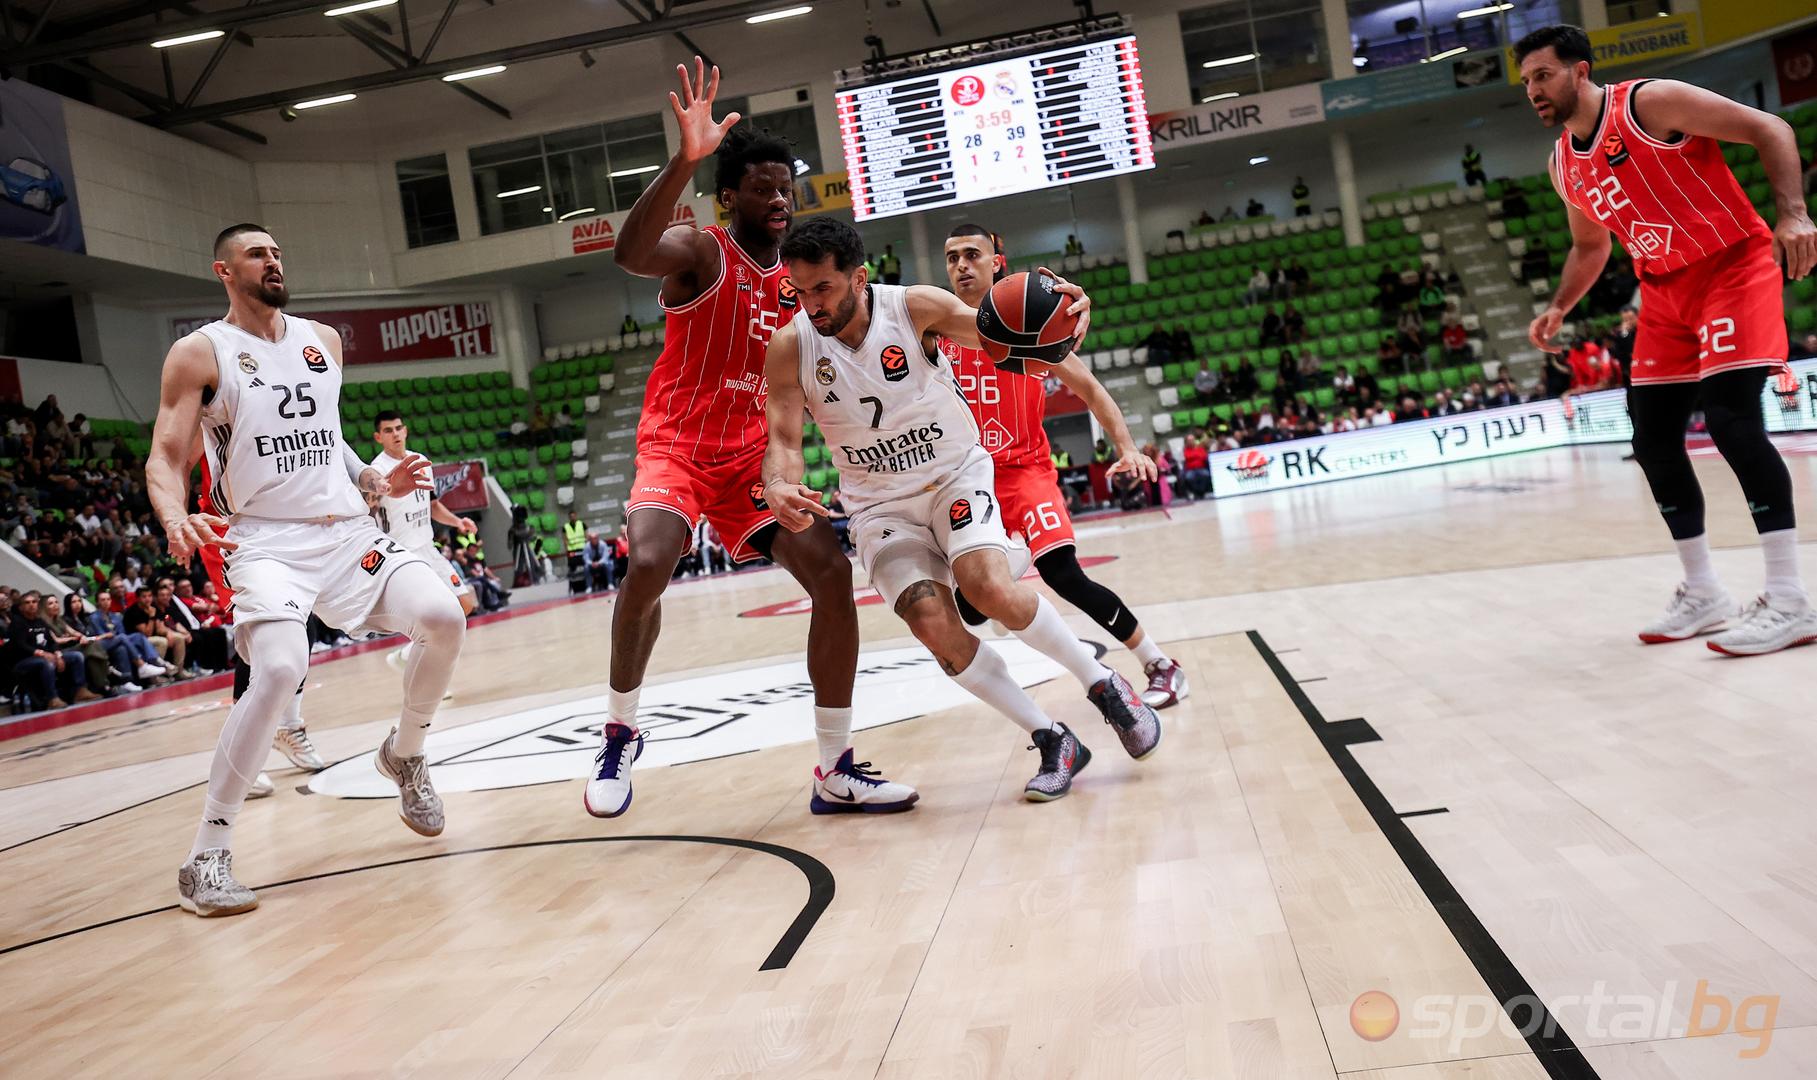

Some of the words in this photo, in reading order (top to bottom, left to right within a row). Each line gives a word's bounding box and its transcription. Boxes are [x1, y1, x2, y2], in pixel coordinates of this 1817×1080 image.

[975, 109, 1012, 129] 3:59
[1006, 126, 1025, 140] 39
[964, 133, 982, 148] 28
[993, 150, 1000, 162] 2
[1016, 145, 1024, 158] 2
[971, 154, 977, 166] 1
[1587, 175, 1631, 221] 22
[380, 305, 462, 351] HAPOEL
[451, 330, 486, 357] TEL
[1698, 317, 1736, 359] 22
[271, 382, 317, 419] 25
[959, 375, 1000, 405] 26
[859, 396, 884, 429] 7
[840, 422, 944, 465] Emirates
[983, 430, 1002, 447] IBI
[1431, 424, 1469, 456] כץ
[1482, 413, 1546, 449] רענן
[276, 455, 296, 474] FLY
[299, 449, 331, 468] BETTE
[889, 443, 936, 473] BETTER
[1282, 445, 1330, 479] RK
[1335, 449, 1409, 473] CENTERS
[974, 490, 994, 525] 7
[1024, 502, 1062, 541] 26
